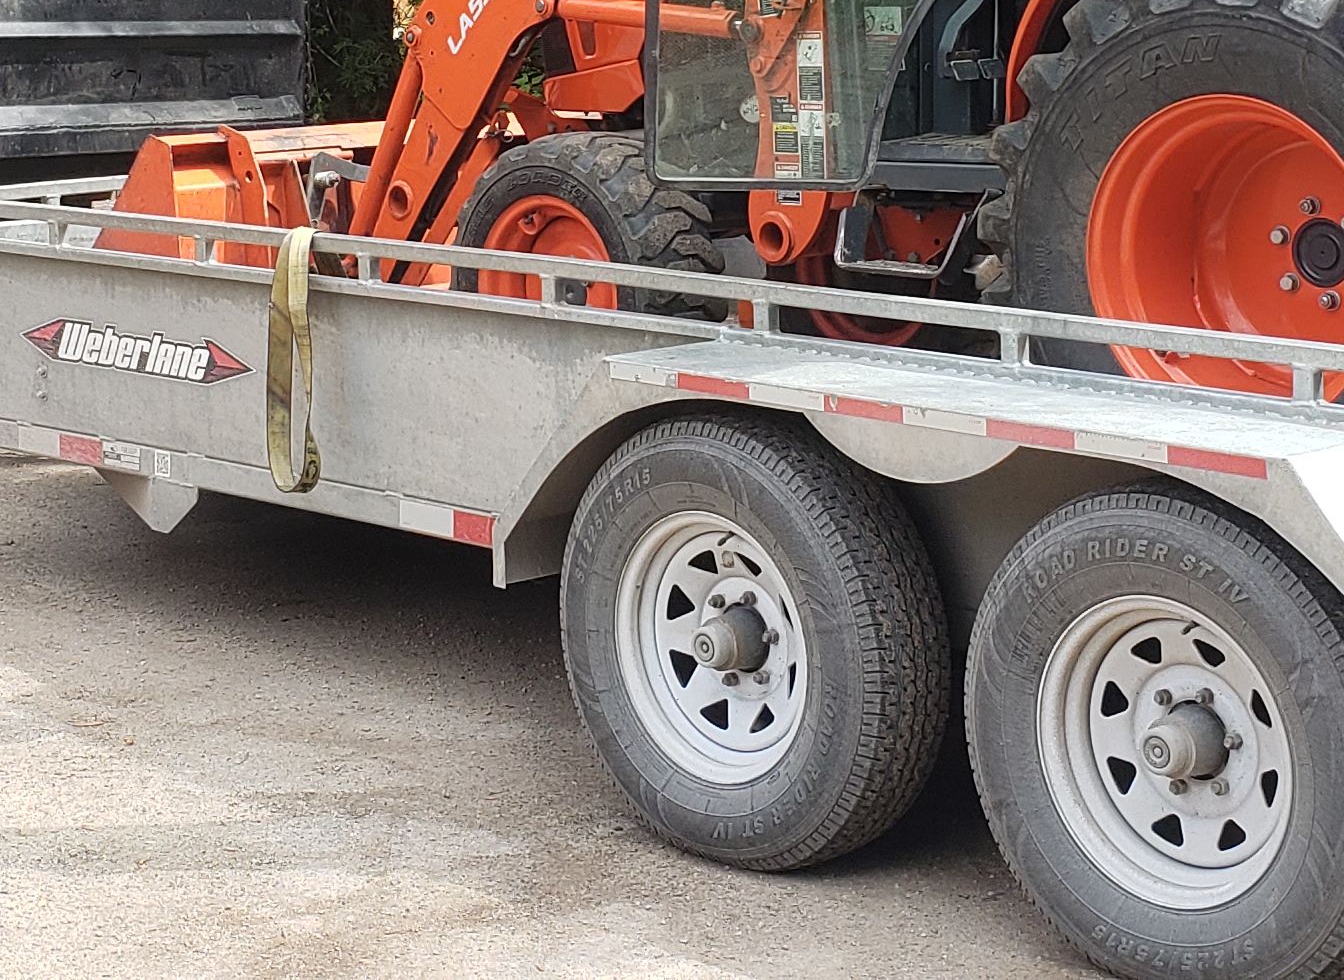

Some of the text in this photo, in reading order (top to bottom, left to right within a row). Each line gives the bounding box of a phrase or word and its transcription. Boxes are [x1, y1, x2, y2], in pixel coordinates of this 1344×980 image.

[1060, 33, 1222, 153] TITAN
[1020, 537, 1250, 604] ROAD RIDER ST IV
